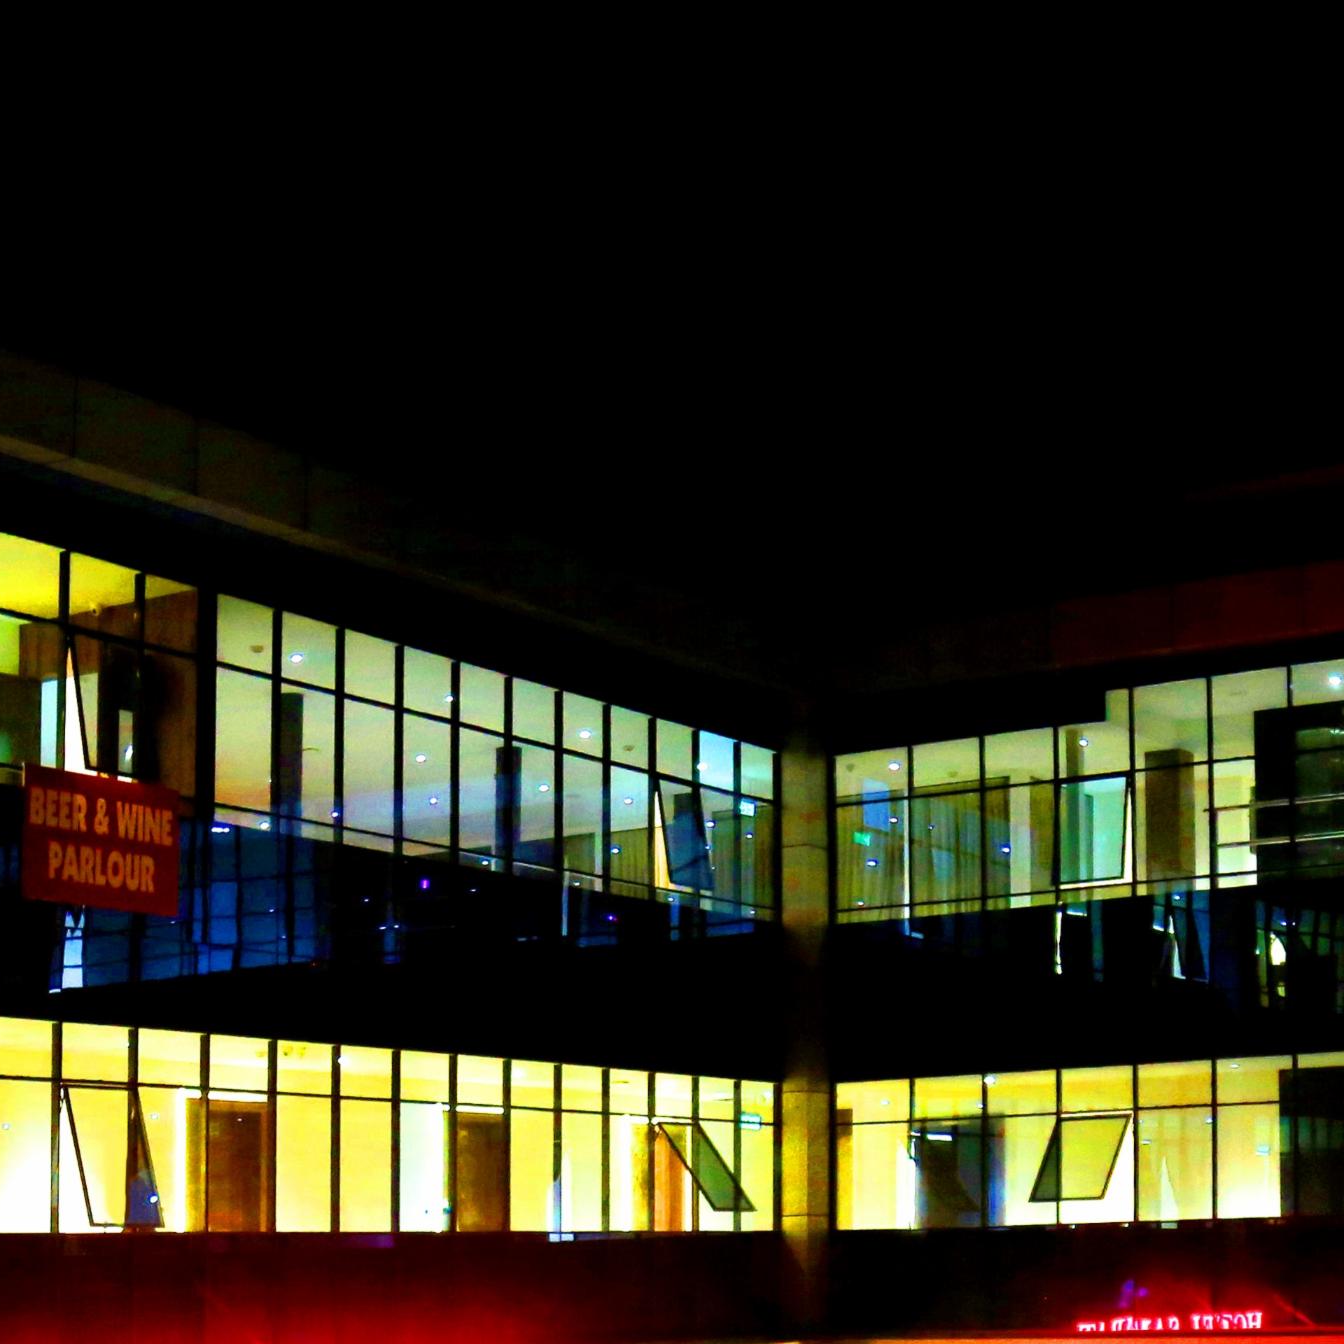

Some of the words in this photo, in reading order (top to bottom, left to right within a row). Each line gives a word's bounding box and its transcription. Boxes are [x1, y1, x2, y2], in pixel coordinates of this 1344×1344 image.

[29, 786, 87, 833] BEER
[94, 798, 110, 835] &
[116, 801, 173, 846] WINE
[48, 841, 155, 893] PARLOUR
